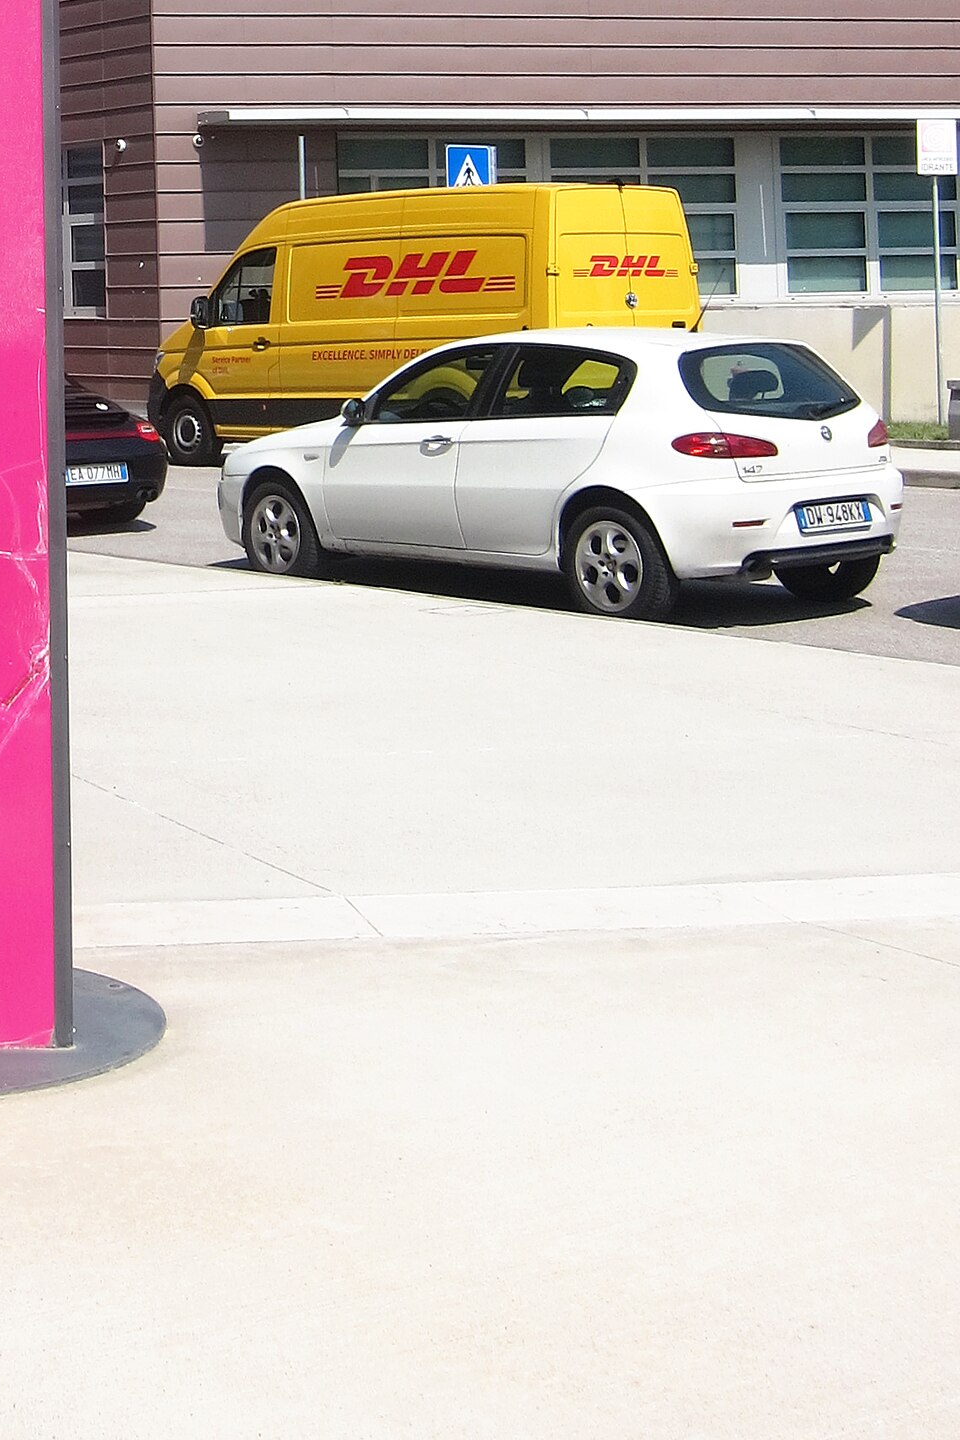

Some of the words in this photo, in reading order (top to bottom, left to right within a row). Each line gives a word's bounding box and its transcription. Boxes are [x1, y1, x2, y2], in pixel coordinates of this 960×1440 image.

[340, 250, 486, 298] DHL
[589, 255, 666, 277] DHL
[311, 350, 368, 361] EXCELLENCE.
[369, 349, 402, 360] SIMPLY
[742, 465, 763, 473] 147
